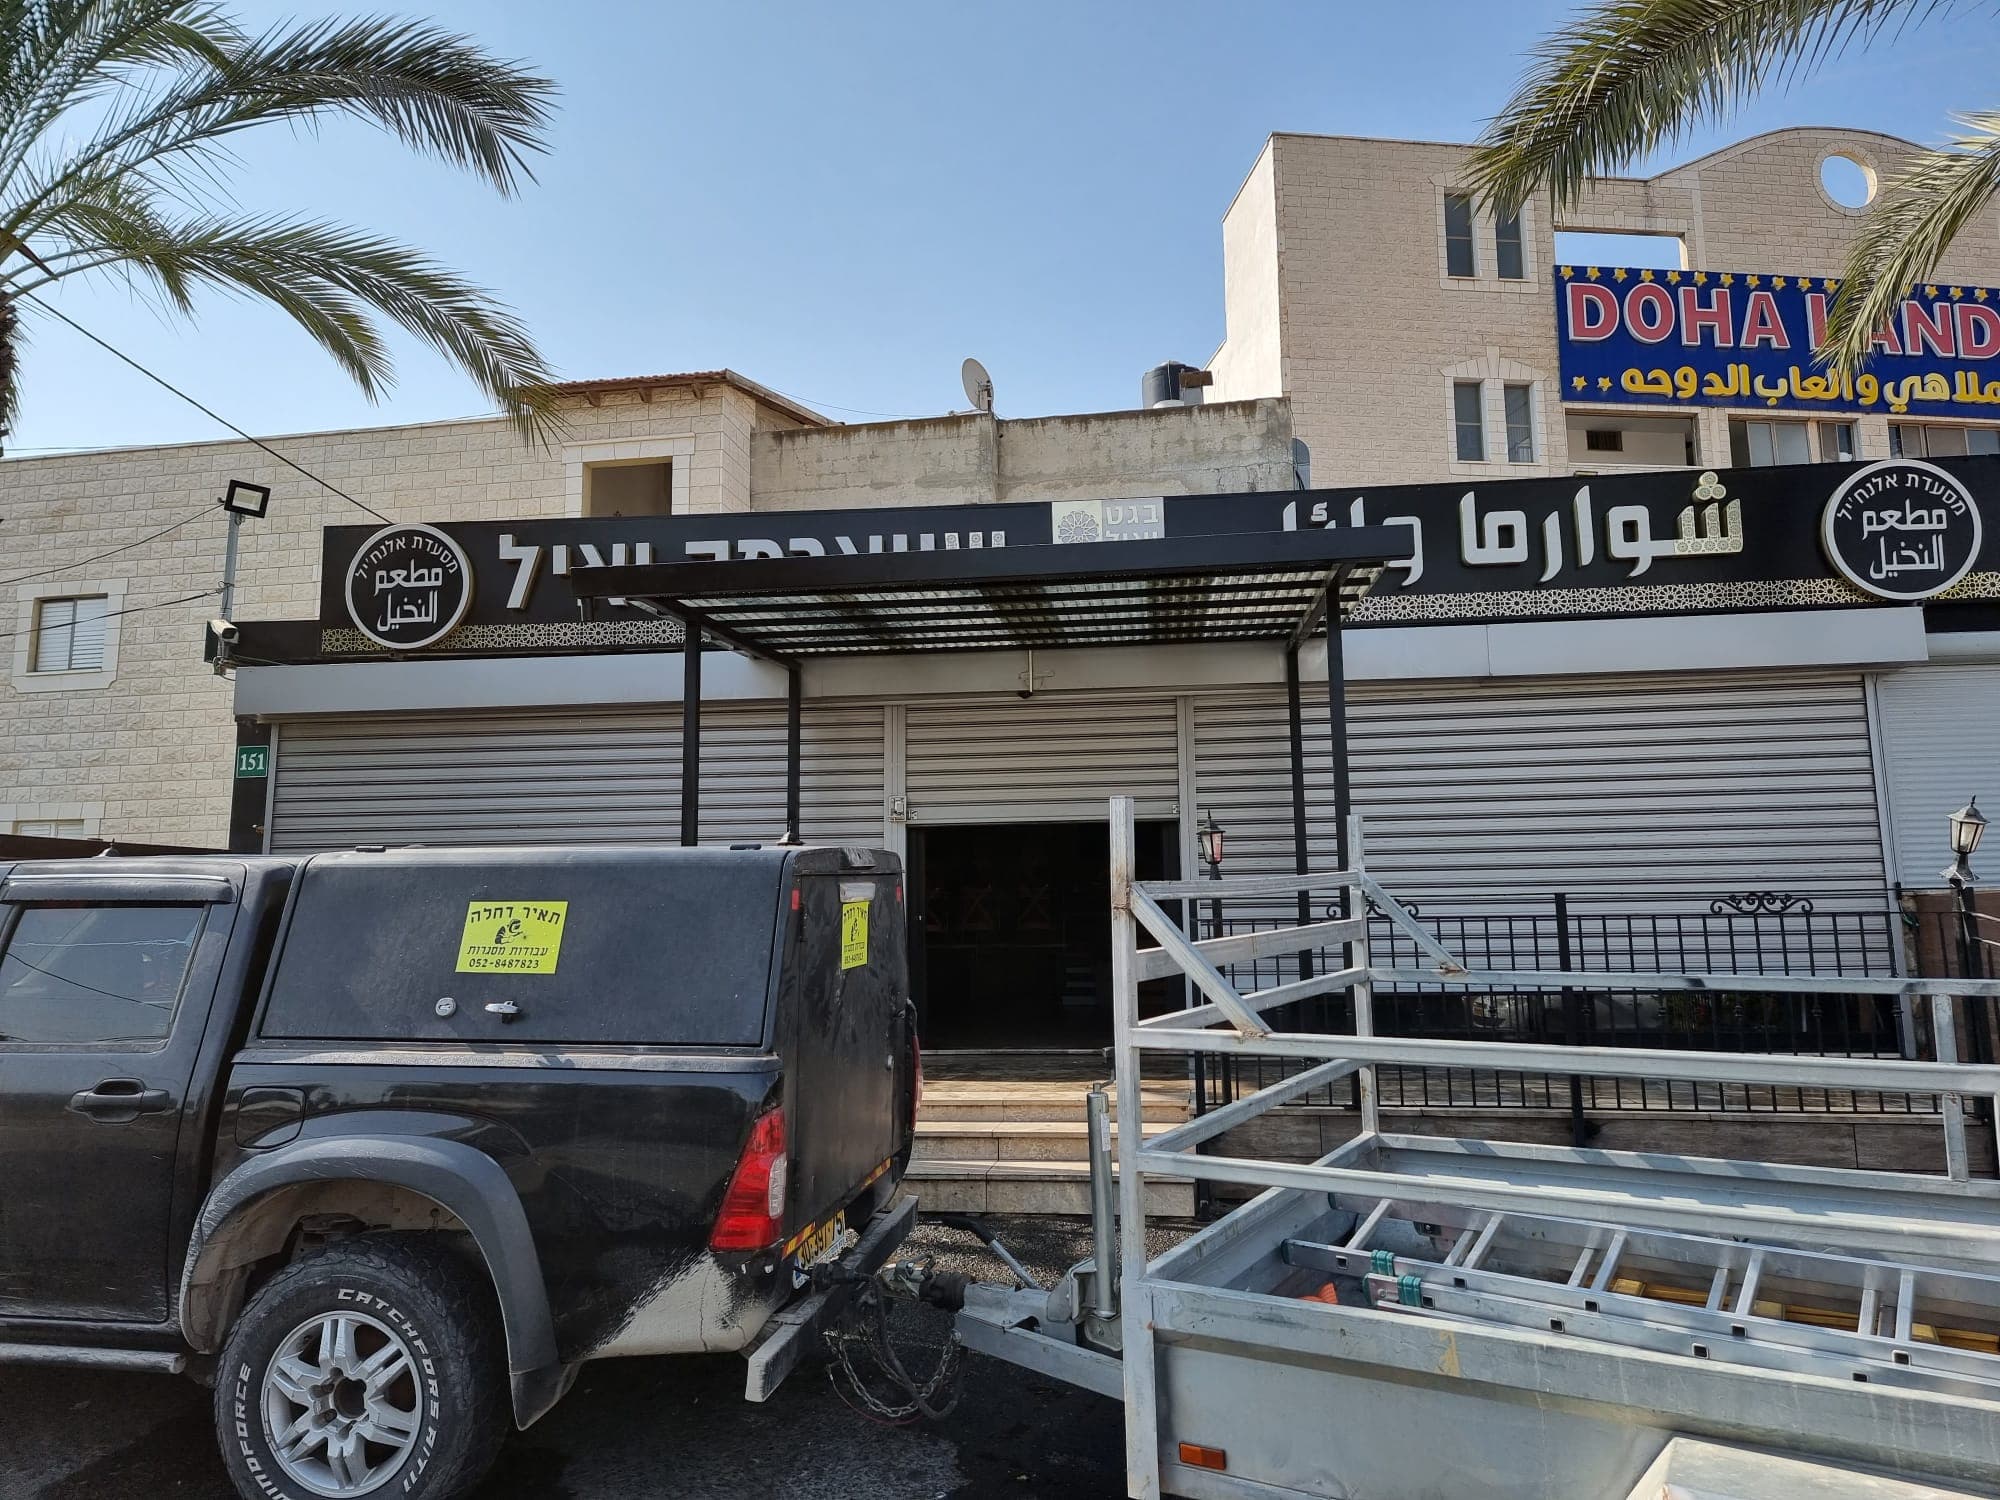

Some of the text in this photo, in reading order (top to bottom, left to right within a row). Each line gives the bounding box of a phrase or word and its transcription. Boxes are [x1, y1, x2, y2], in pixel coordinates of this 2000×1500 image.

[1566, 282, 1791, 350] DOHA
[1620, 362, 1750, 399] الدوحه
[1905, 473, 1967, 516] מסעדת
[1105, 504, 1160, 525] בגט
[1459, 471, 1744, 584] شوارما
[1861, 498, 1948, 541] مطعم
[411, 535, 458, 574] מסעדת
[1869, 533, 1945, 580] النخيل
[373, 558, 443, 597] مطعم
[376, 590, 438, 632] النخيل
[240, 753, 264, 770] 151
[470, 906, 561, 925] תאיר דחלה
[468, 958, 540, 969] 052-8487823
[508, 946, 549, 956] עבודות
[337, 1288, 440, 1420] CATCHFORS
